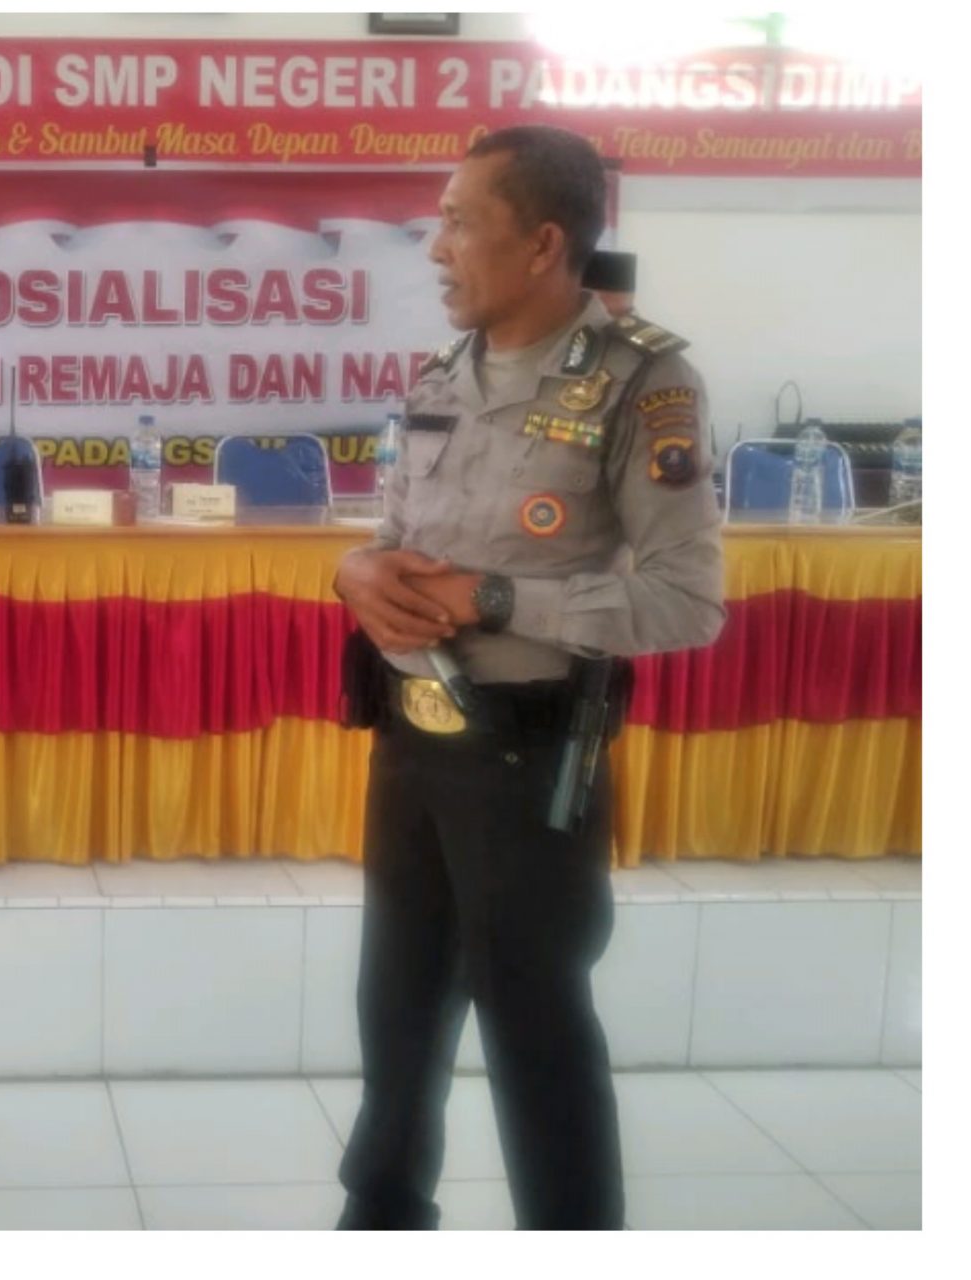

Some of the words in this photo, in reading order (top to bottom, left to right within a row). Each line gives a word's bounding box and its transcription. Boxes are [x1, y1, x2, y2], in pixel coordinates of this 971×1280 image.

[54, 54, 178, 108] SMP
[198, 55, 415, 109] NEGERI
[436, 56, 469, 109] 2
[7, 124, 33, 155] &
[39, 123, 147, 155] Sambut
[153, 124, 238, 155] Masa
[246, 125, 340, 163] Depan
[349, 125, 460, 164] Dengan
[613, 126, 686, 167] Tetap
[693, 127, 832, 170] Semangat
[837, 131, 893, 160] dan
[18, 353, 212, 403] REMAJA
[228, 352, 323, 402] DAN
